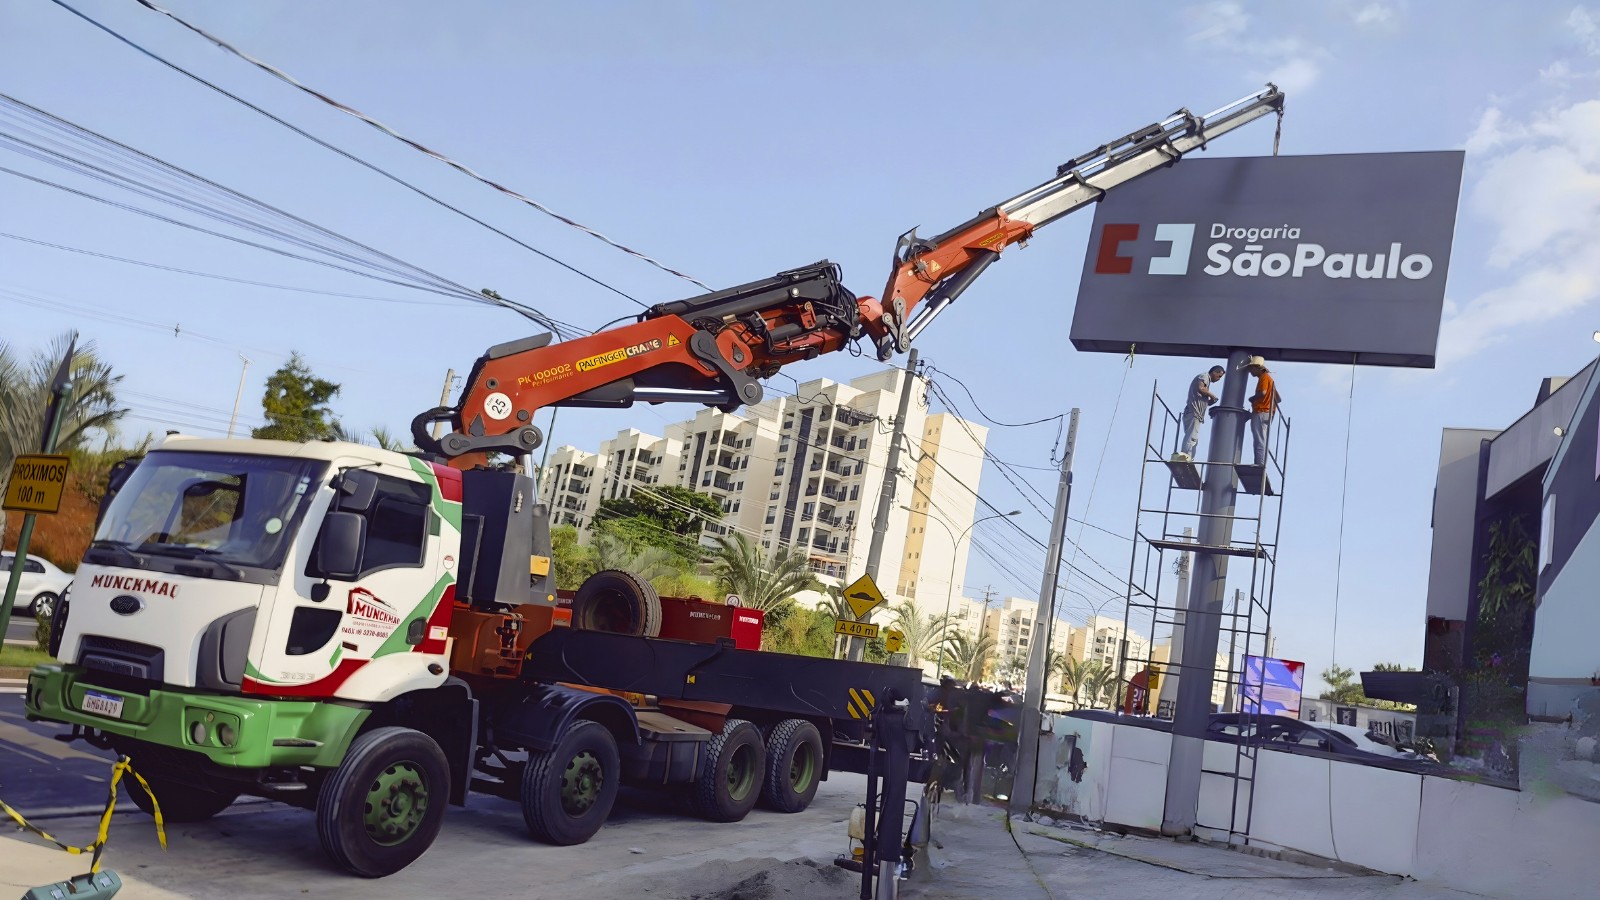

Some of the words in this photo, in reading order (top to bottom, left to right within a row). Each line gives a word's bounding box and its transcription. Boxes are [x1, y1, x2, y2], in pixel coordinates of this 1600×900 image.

[1210, 222, 1301, 243] Drogaria
[578, 349, 626, 372] PALFINGER
[626, 338, 661, 358] CRANE
[517, 375, 532, 386] PK
[533, 363, 573, 381] 100002
[532, 371, 574, 388] Performance
[491, 398, 506, 415] 25
[17, 486, 33, 503] 100
[34, 490, 45, 504] m
[354, 600, 400, 625] MUNCKMAC
[839, 622, 847, 633] A
[850, 624, 862, 634] 40
[864, 628, 874, 636] m
